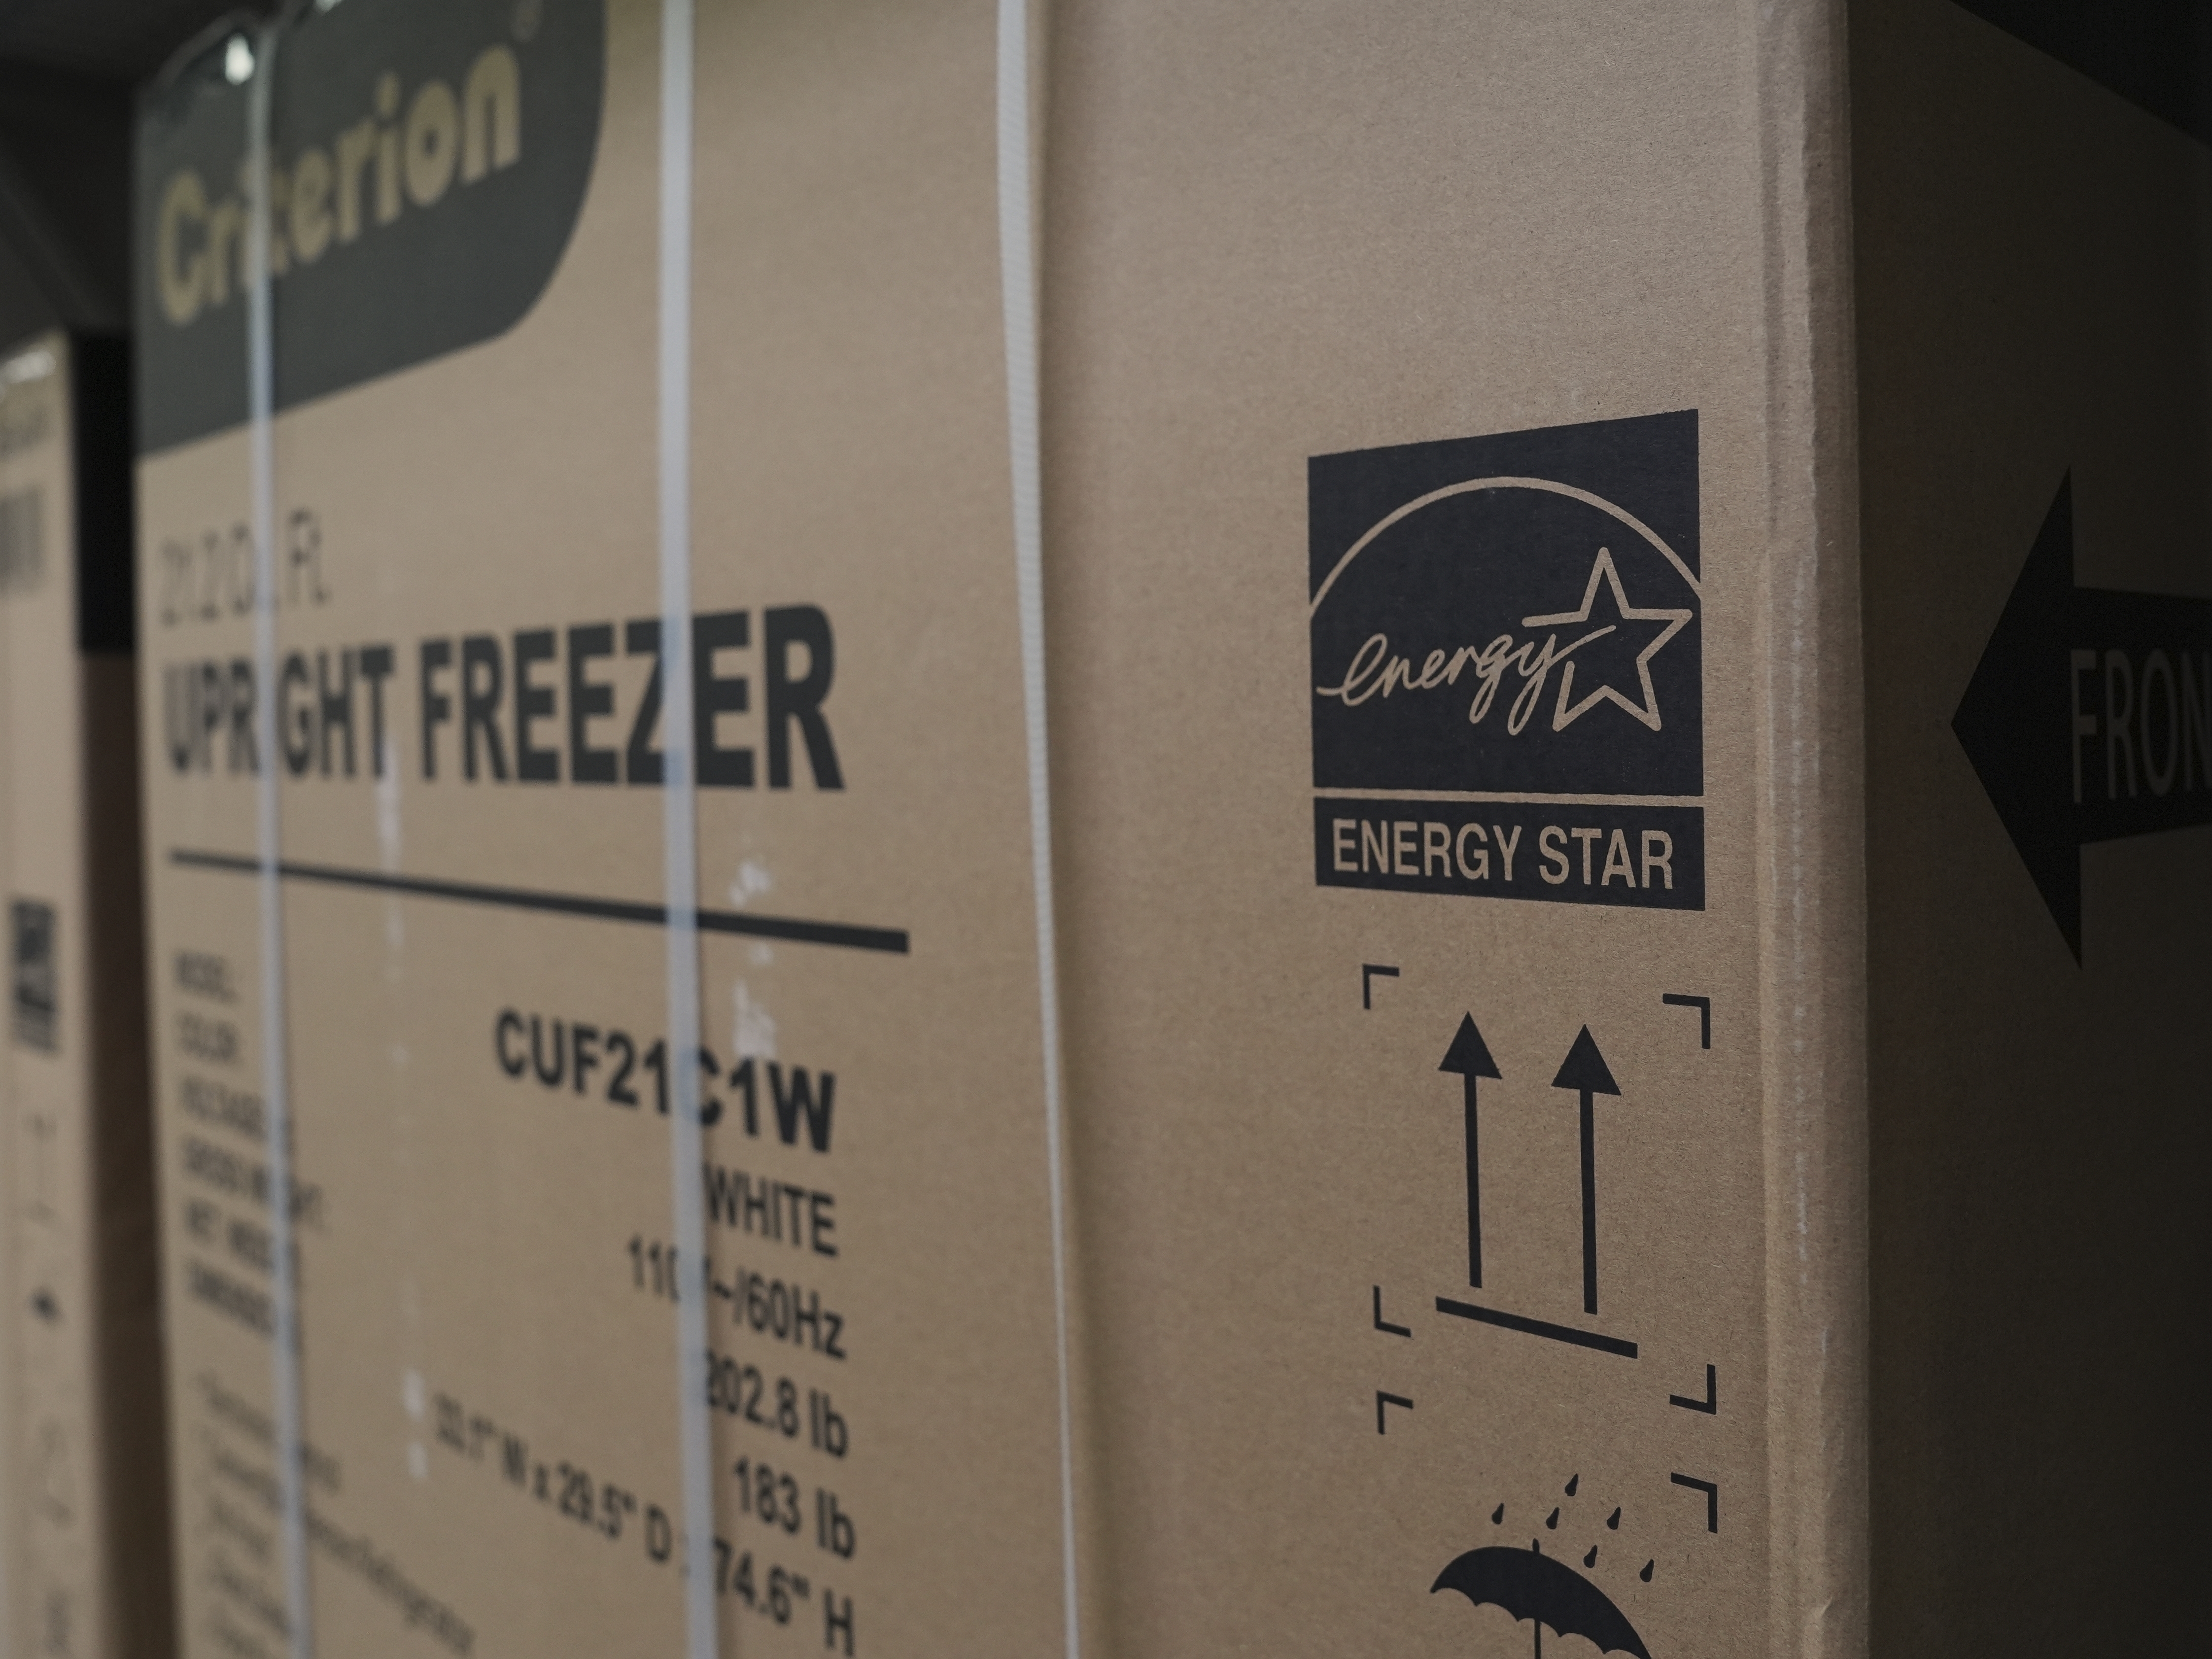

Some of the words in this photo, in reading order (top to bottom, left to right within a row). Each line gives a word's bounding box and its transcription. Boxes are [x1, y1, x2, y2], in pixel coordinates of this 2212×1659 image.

[164, 643, 395, 781] UPRGHT
[419, 602, 847, 793] FREEZER
[1316, 633, 1616, 736] energy
[1332, 817, 1522, 881] ENERGY
[1538, 825, 1674, 890] STAR
[704, 1161, 837, 1257] WHITE
[809, 1388, 848, 1459] lb
[733, 1454, 801, 1536] 183
[816, 1486, 856, 1560] lb
[645, 1503, 672, 1565] D
[824, 1587, 855, 1658] H
